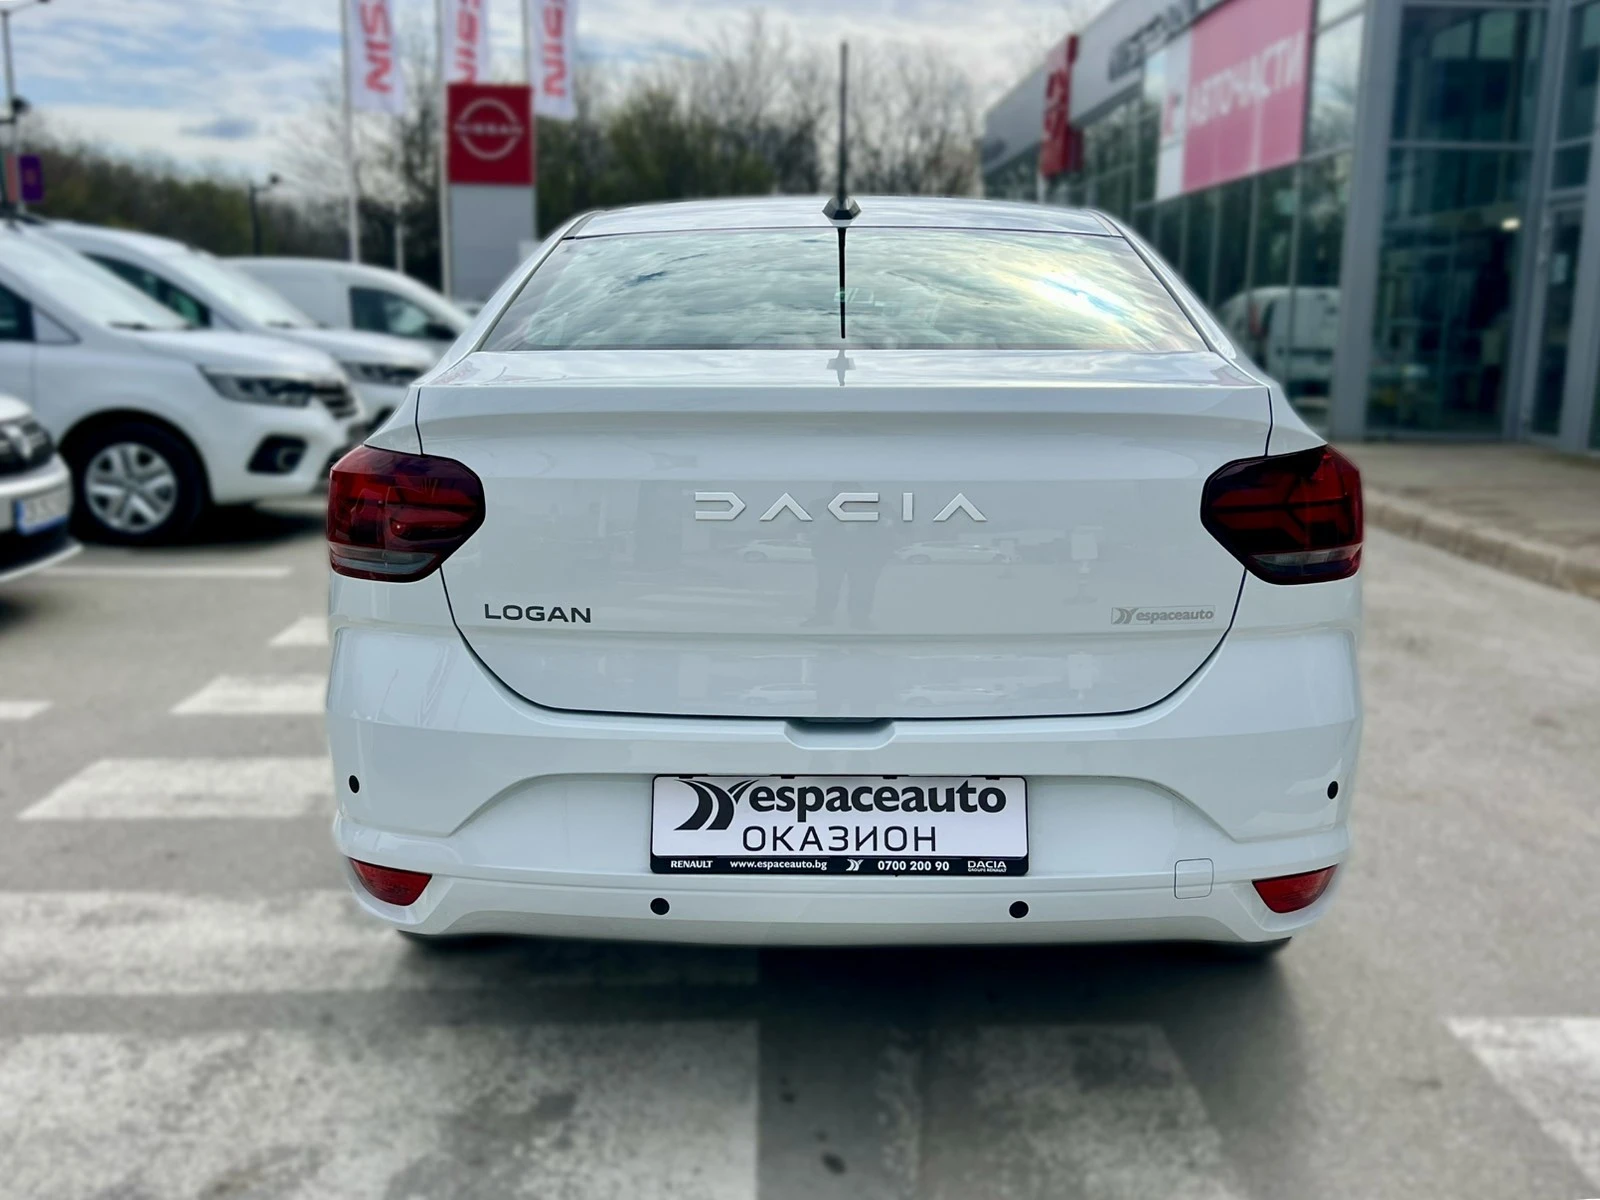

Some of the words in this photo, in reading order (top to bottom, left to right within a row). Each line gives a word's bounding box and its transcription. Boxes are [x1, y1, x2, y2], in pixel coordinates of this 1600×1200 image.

[694, 491, 988, 522] DACIA
[484, 603, 592, 623] LOGAN
[1136, 609, 1215, 624] espaceauto
[748, 779, 1007, 823] espaceauto
[742, 825, 936, 852] ОКАЗИОН
[670, 860, 713, 868] RENAULT
[730, 860, 828, 871] www.espaceauto.bg
[877, 860, 906, 871] 0700
[909, 861, 932, 871] 200
[935, 861, 950, 871] 90
[967, 860, 1007, 868] DACIA
